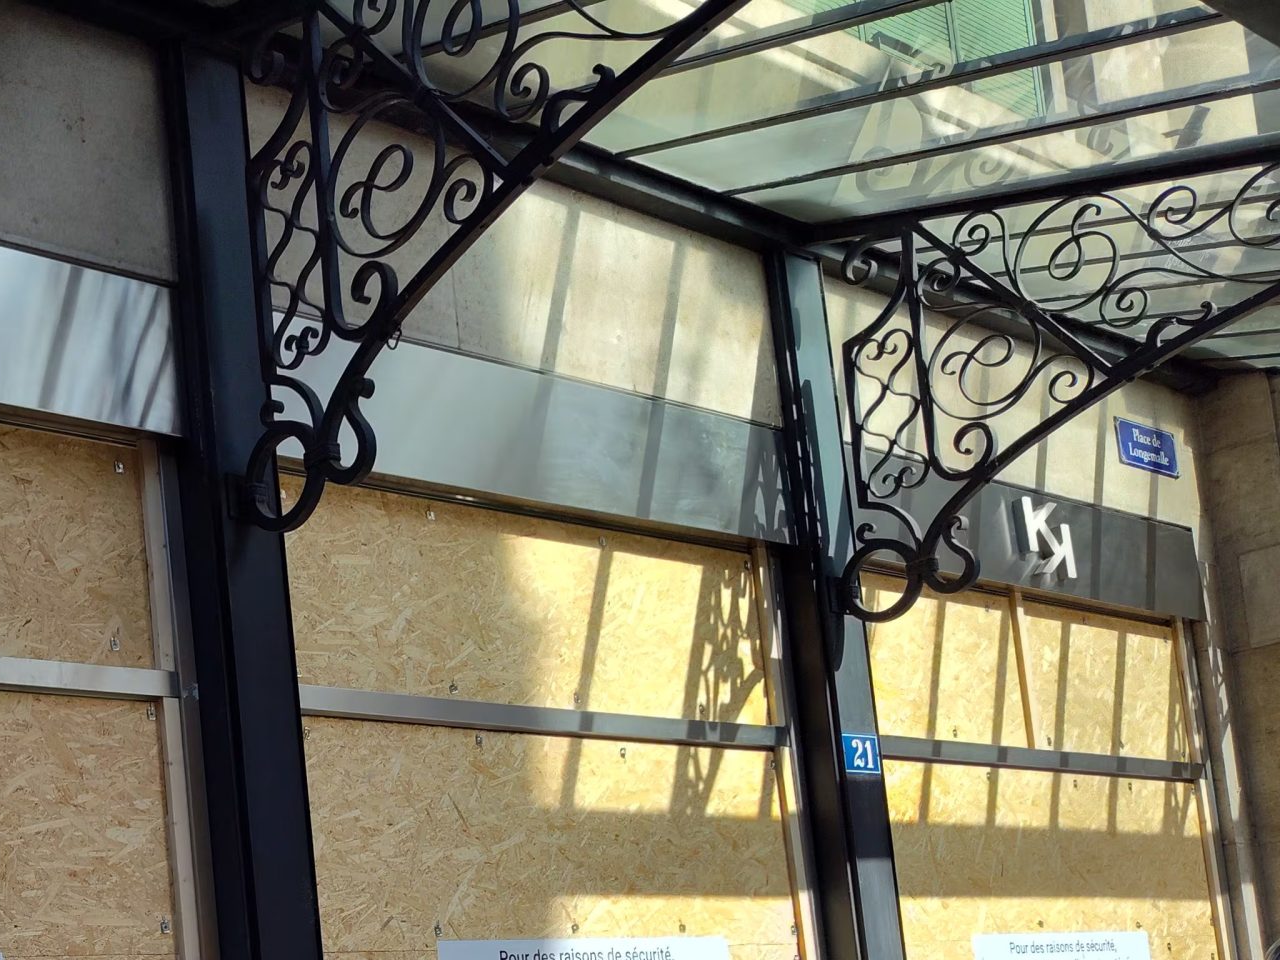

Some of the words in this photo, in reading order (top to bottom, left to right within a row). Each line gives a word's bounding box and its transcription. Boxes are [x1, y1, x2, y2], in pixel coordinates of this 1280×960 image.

[1132, 428, 1151, 445] Place
[1152, 434, 1161, 448] de
[851, 738, 874, 768] 21
[1009, 941, 1028, 955] Pour
[1030, 940, 1045, 954] des
[1046, 940, 1074, 953] raisons
[1075, 939, 1085, 952] de
